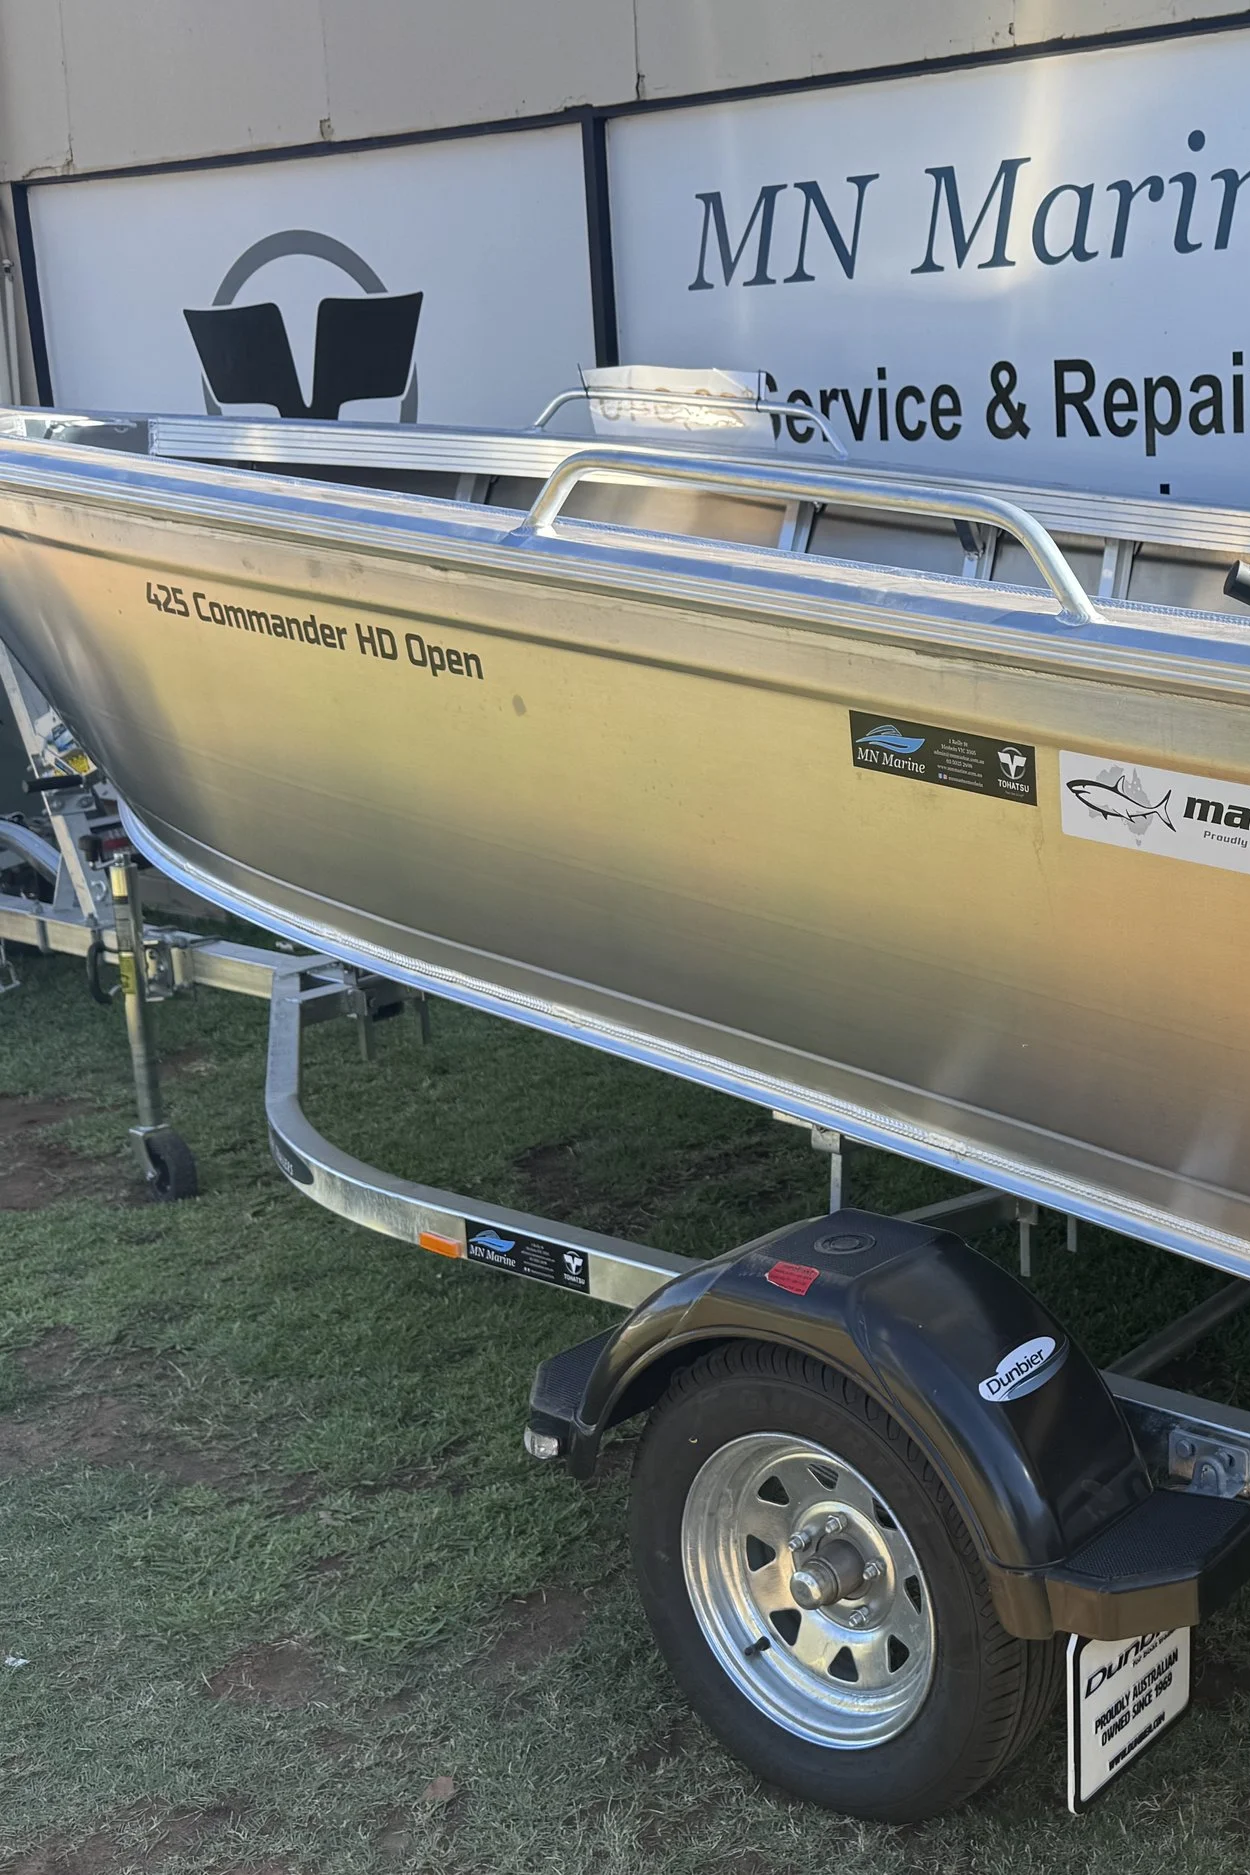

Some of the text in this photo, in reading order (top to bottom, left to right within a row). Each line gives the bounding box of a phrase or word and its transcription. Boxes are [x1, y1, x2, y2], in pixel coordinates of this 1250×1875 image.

[687, 173, 880, 291] MN
[986, 360, 1031, 442] &
[146, 581, 485, 680] 425 Commander HD Open
[856, 747, 880, 764] MN
[881, 752, 926, 774] Marine
[997, 778, 1030, 793] TOHATSU
[1203, 829, 1250, 849] Proudly
[470, 1244, 485, 1258] MN
[486, 1250, 516, 1267] Marine
[986, 1349, 1044, 1395] Dunbier
[1094, 1648, 1179, 1735] PROUDLY AUSTRALIAN
[1101, 1710, 1131, 1747] OWNED
[1132, 1690, 1153, 1720] SINCE
